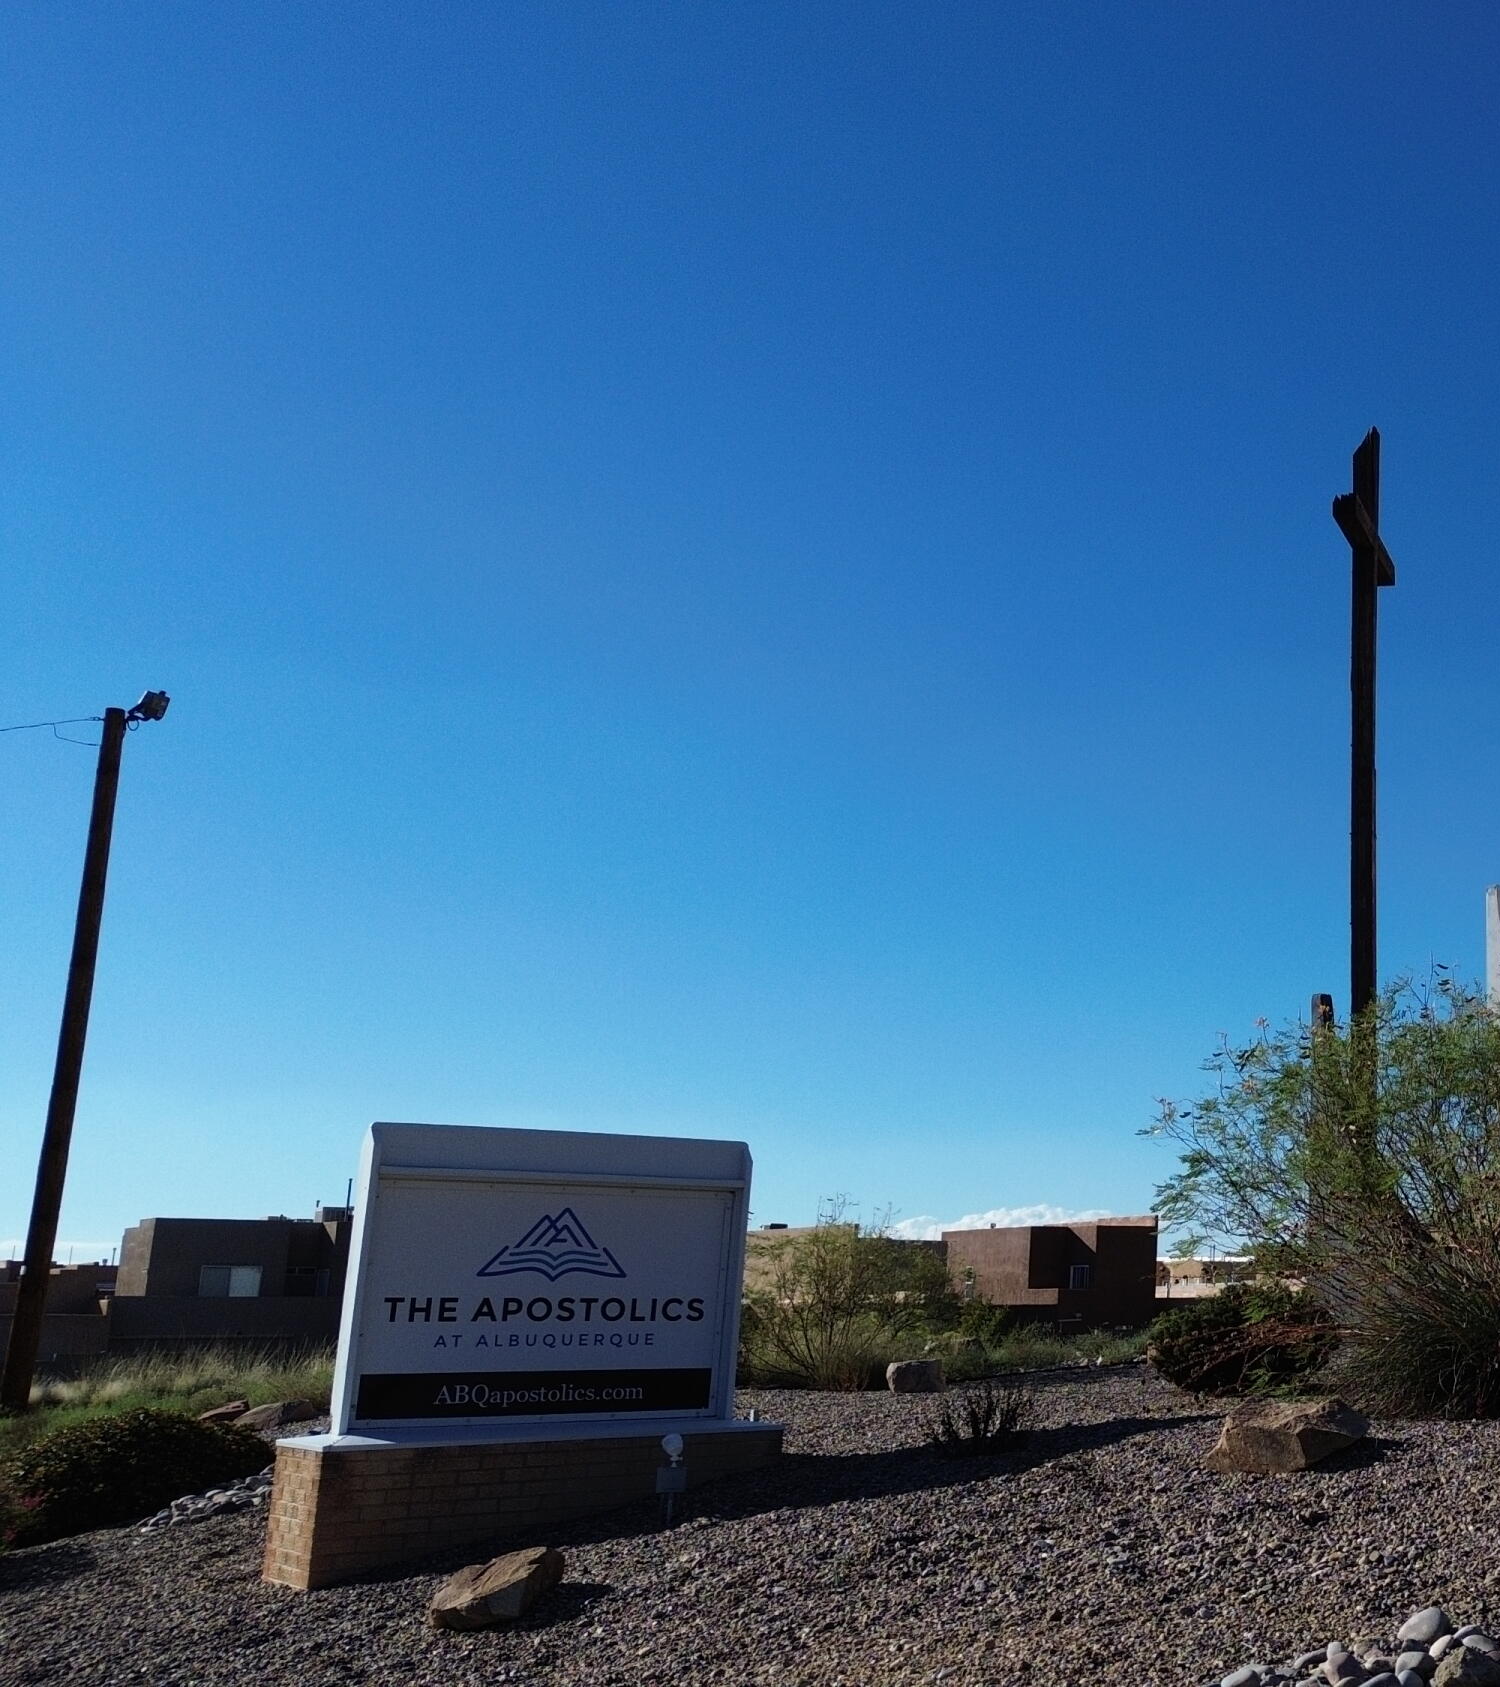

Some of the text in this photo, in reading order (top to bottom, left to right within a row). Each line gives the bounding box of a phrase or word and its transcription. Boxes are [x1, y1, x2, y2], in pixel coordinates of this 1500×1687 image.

[384, 1297, 705, 1322] THE APOSTOLICS
[434, 1333, 655, 1348] AT ALBUQUERQUE
[434, 1384, 643, 1407] ABQapostolics.com
